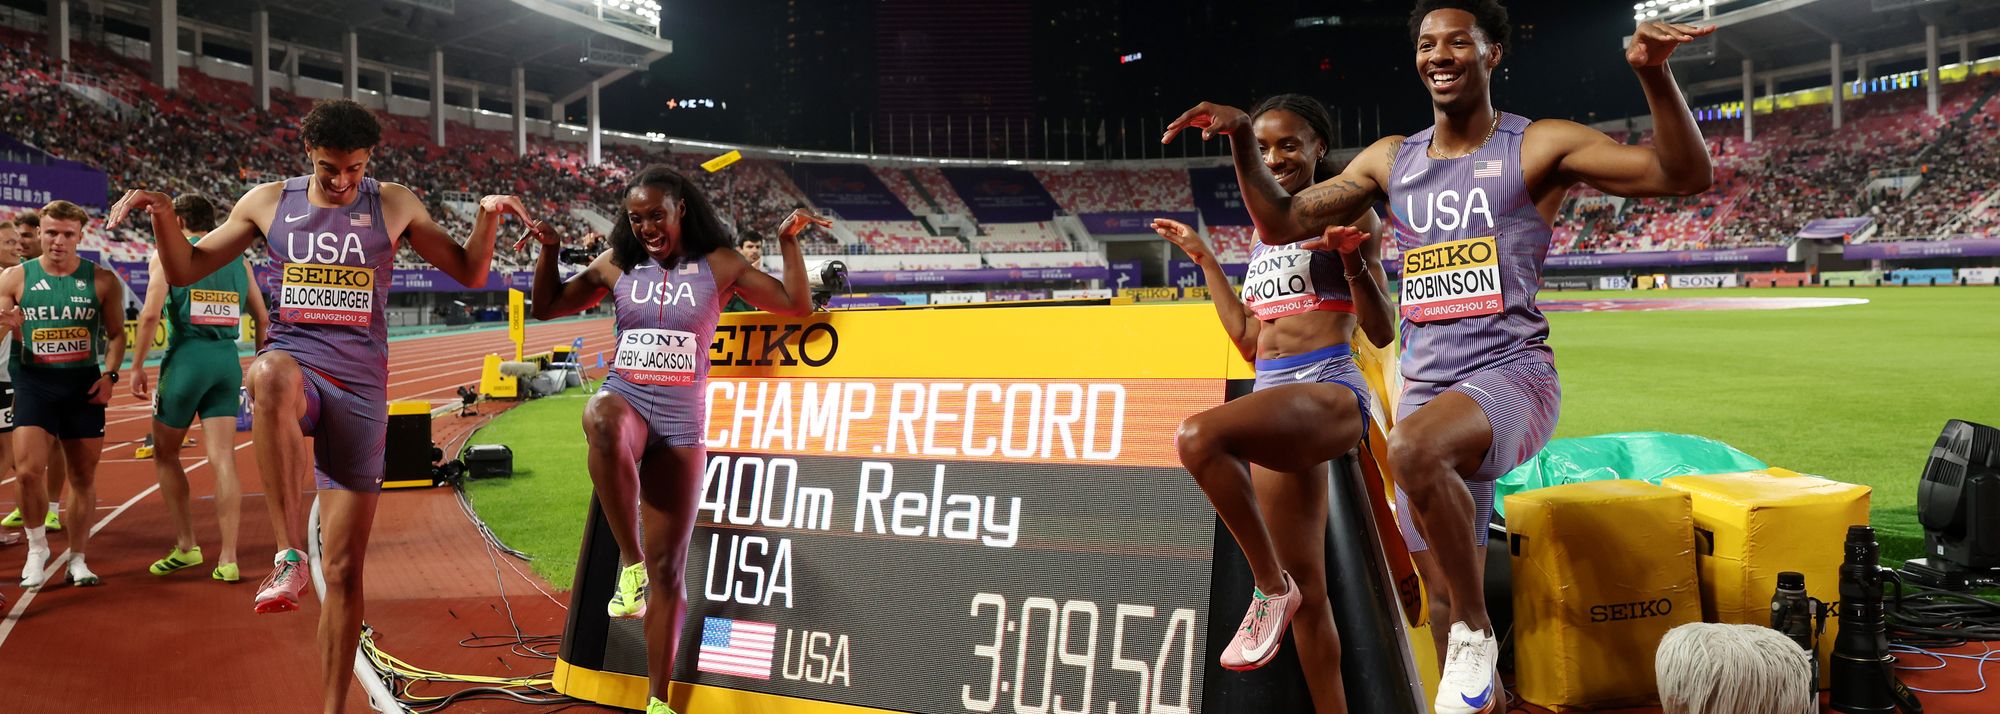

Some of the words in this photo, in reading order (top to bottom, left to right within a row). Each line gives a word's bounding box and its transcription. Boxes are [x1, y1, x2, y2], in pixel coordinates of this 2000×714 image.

[1407, 187, 1495, 233] USA
[287, 232, 366, 264] USA
[1406, 242, 1491, 274] SEIKO
[286, 266, 370, 287] SEIKO
[1248, 253, 1302, 279] SONY
[630, 279, 696, 307] USA
[1244, 274, 1306, 303] OKOLO
[1406, 268, 1495, 301] ROBINSON
[1606, 277, 1628, 288] TBS
[1679, 276, 1727, 287] SONY
[193, 291, 239, 303] SEIKO
[285, 288, 369, 309] BLOCKBURGER
[1126, 288, 1170, 299] SEIKO
[203, 304, 231, 316] AUS
[303, 312, 357, 322] GUANGZHOU
[358, 315, 368, 323] 25
[1423, 301, 1483, 316] GUANGZHOU
[1486, 299, 1498, 309] 25
[34, 328, 88, 340] SEIKO
[626, 332, 690, 348] SONY
[709, 323, 839, 367] EIKO
[36, 340, 88, 353] KEANE
[617, 350, 693, 370] IRBY-JACKSON
[633, 373, 682, 382] GUANGZHOU
[705, 381, 1126, 460] CHAMP.RECORD
[854, 461, 1022, 548] Relay
[704, 533, 793, 608] USA
[1590, 598, 1672, 623] SEIKO
[782, 628, 851, 687] USA
[962, 592, 1196, 714] 3:09.54
